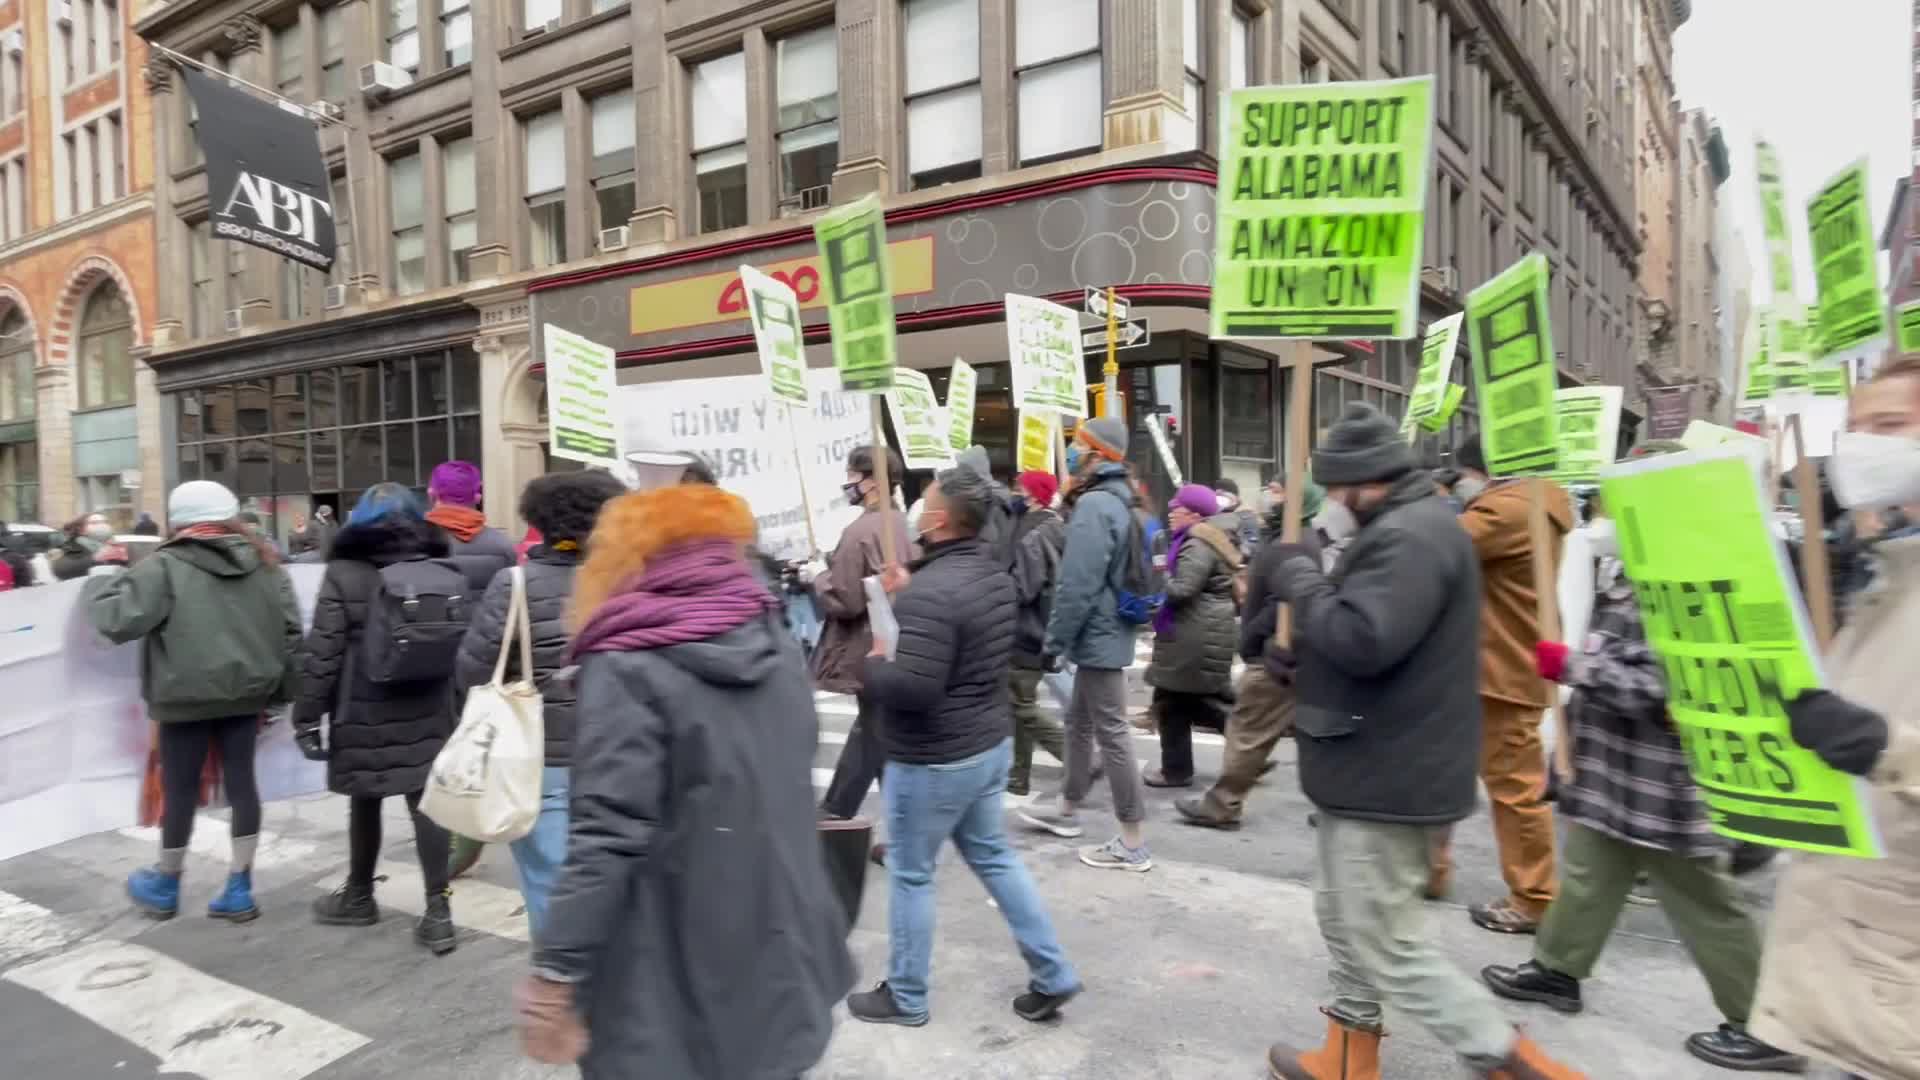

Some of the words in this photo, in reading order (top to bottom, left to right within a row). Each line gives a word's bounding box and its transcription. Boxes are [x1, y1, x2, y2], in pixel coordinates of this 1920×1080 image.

[1244, 96, 1407, 147] SUPPORT
[1236, 152, 1402, 199] ALABAMA
[216, 171, 332, 247] ABT
[1232, 215, 1400, 258] AMAZON
[1248, 262, 1375, 307] UNON
